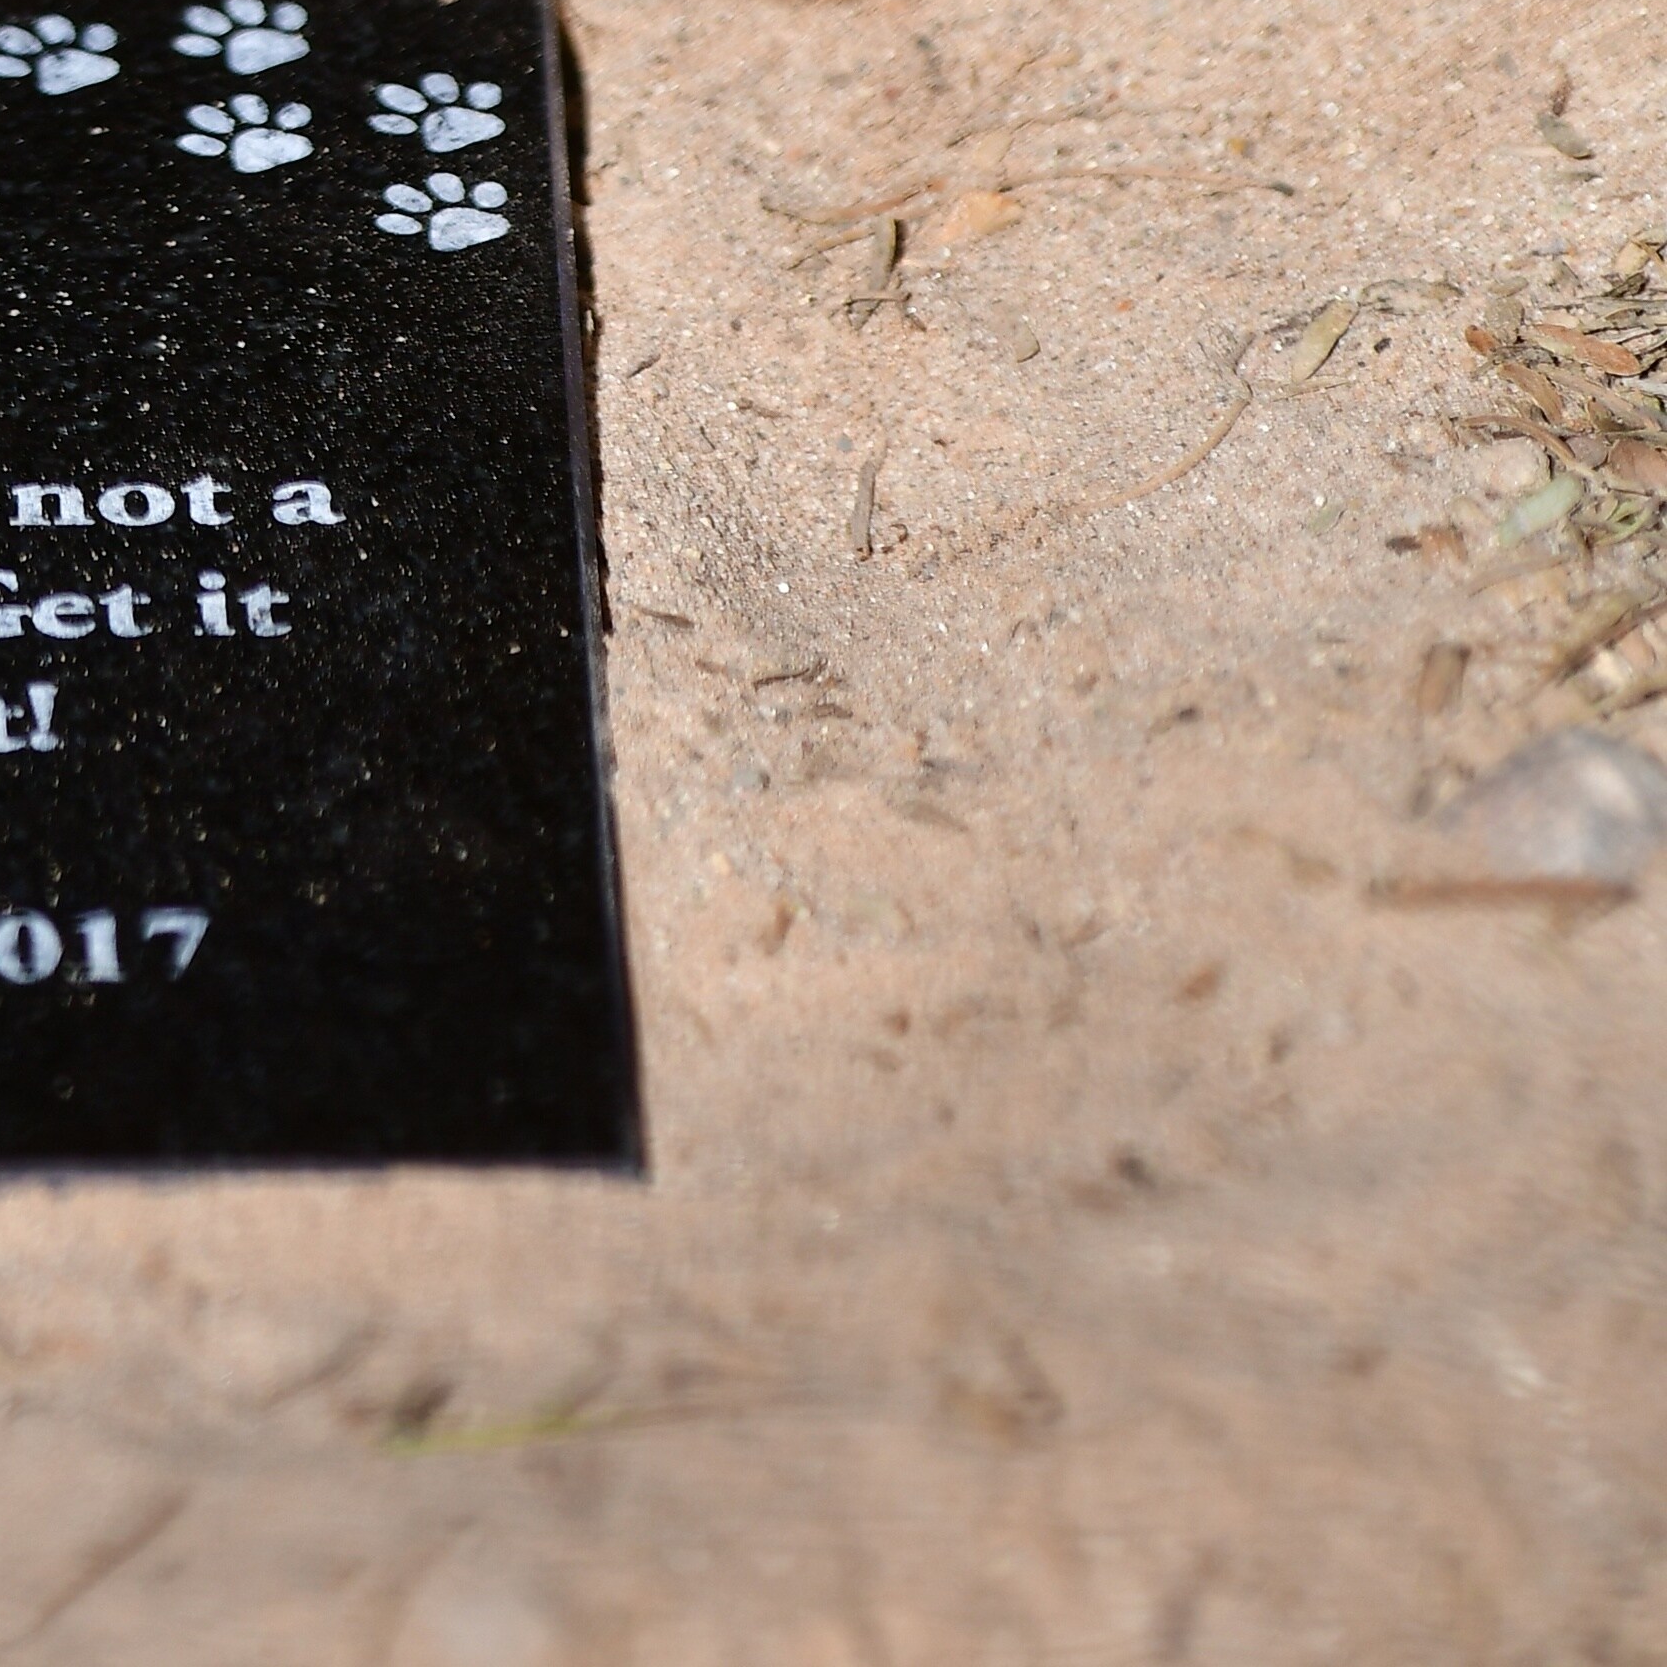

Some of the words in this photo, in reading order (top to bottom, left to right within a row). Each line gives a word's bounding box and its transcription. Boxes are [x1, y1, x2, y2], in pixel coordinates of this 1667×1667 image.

[8, 473, 234, 529] not
[271, 479, 347, 527] a
[194, 570, 294, 638] it
